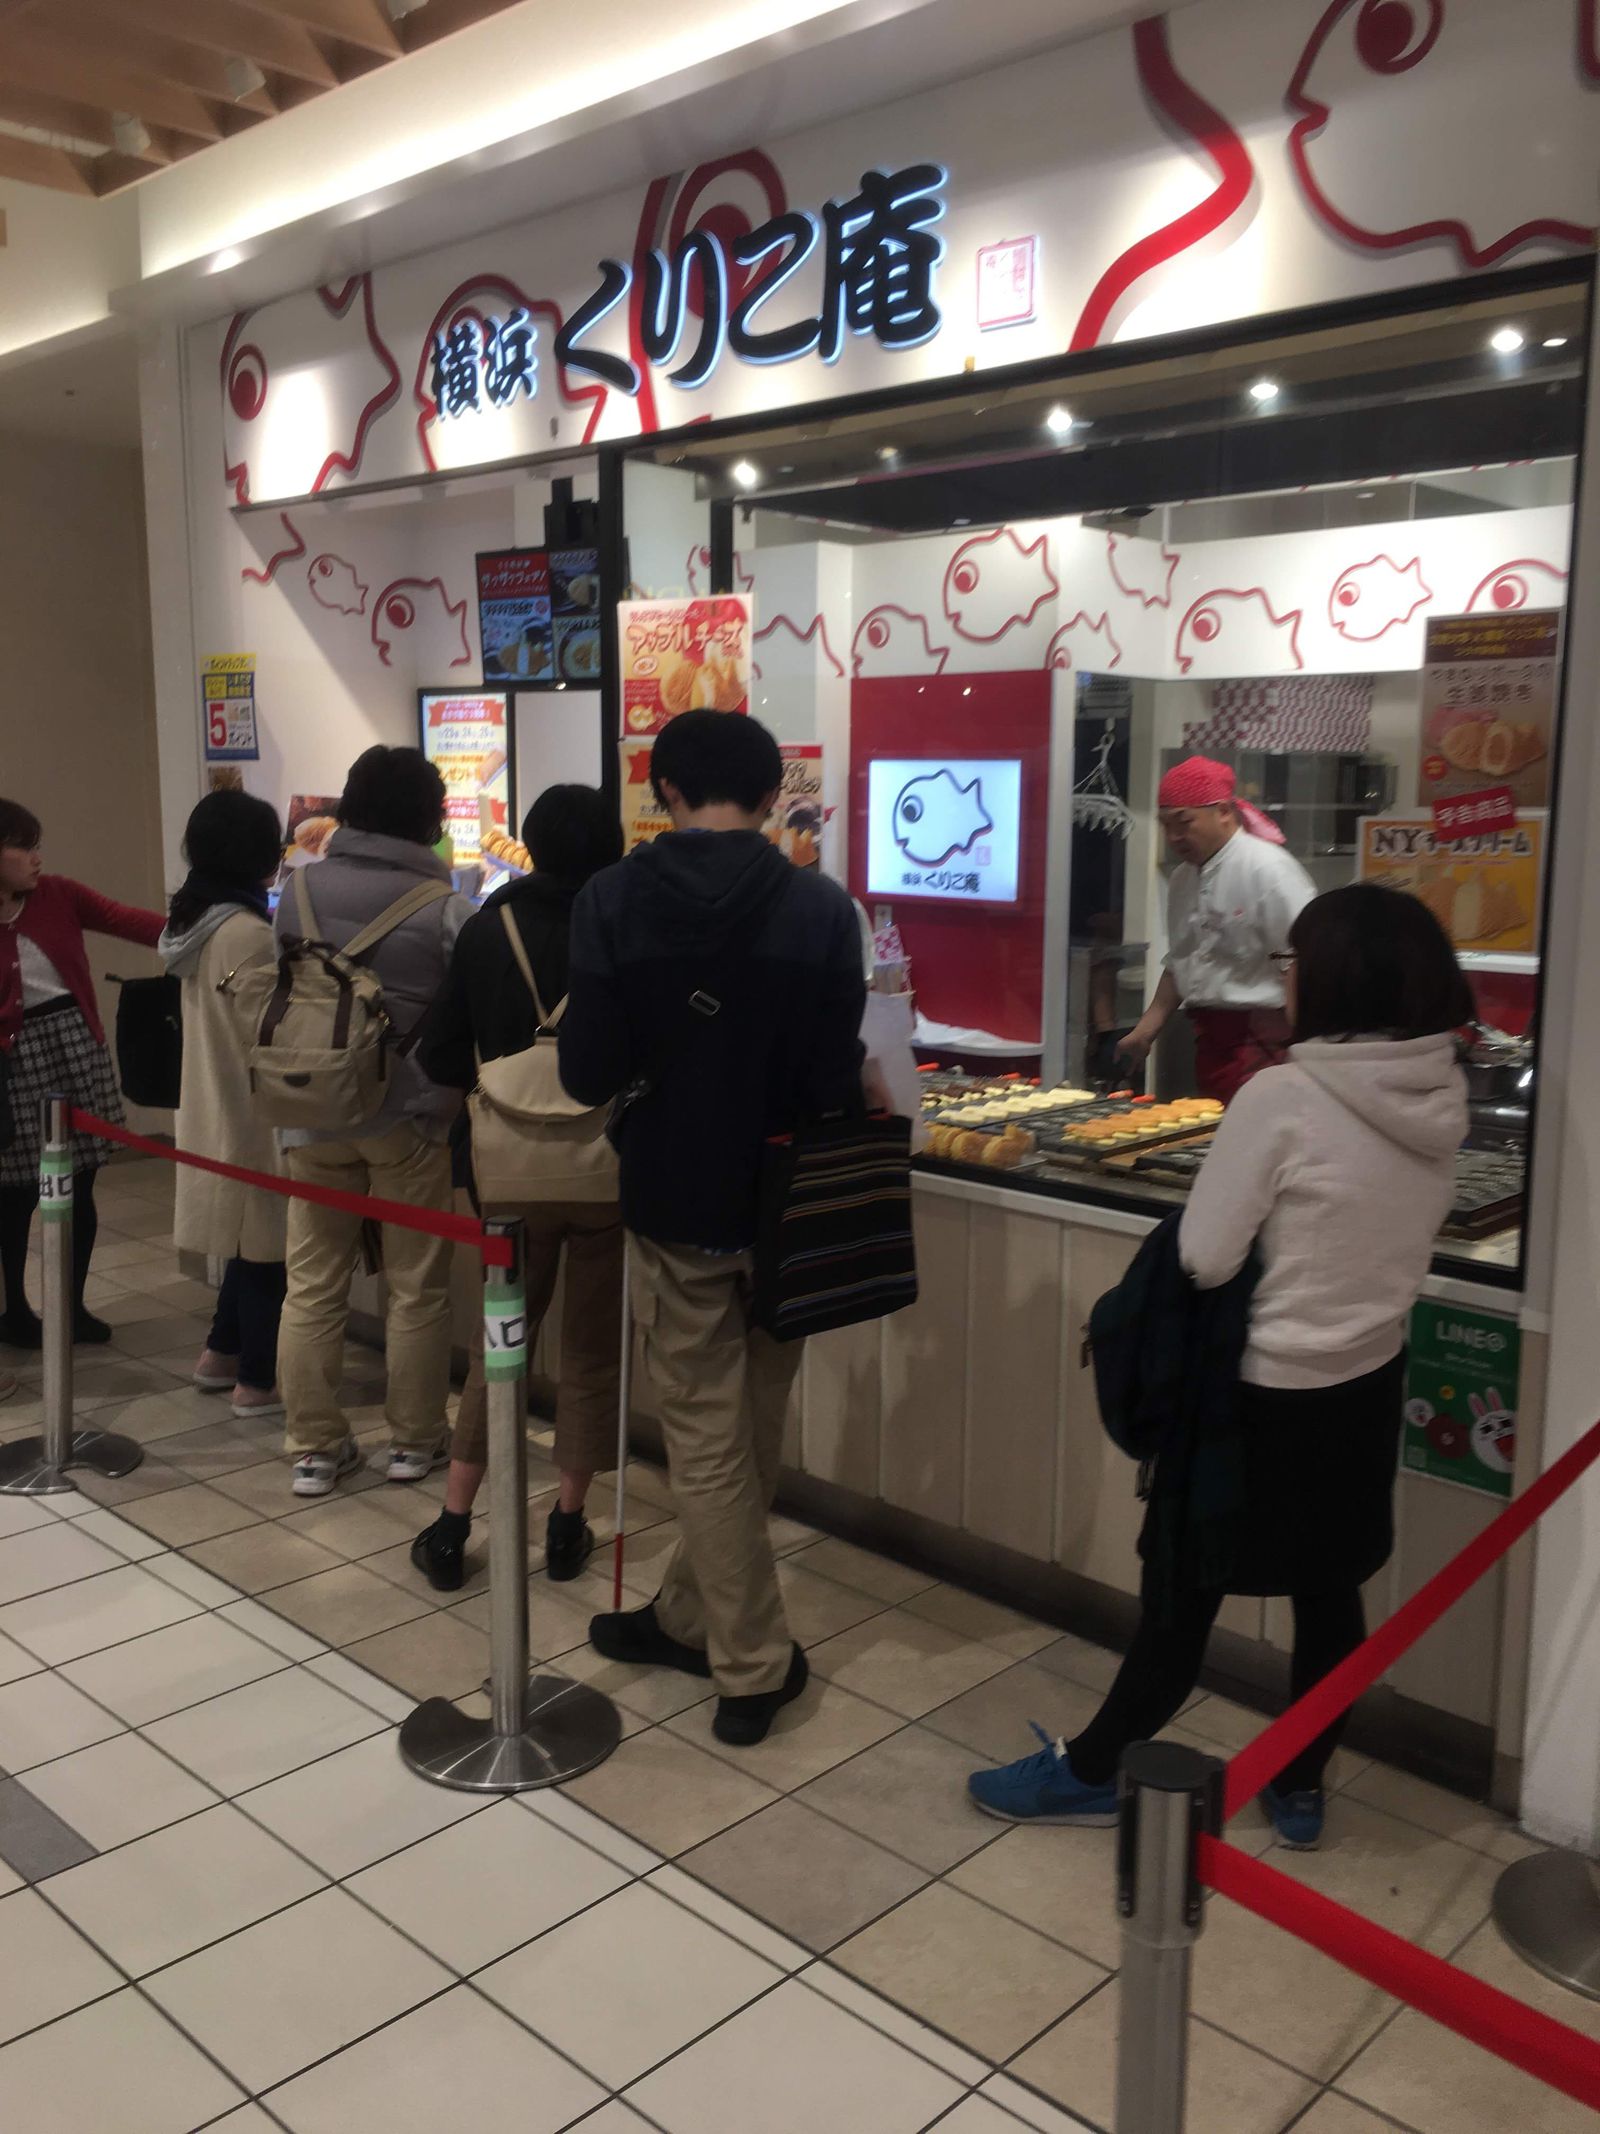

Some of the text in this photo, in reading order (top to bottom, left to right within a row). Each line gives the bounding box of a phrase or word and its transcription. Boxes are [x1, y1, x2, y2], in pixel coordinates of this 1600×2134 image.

[431, 161, 949, 422] 横浜 くりこ庵
[209, 702, 228, 748] 5
[924, 871, 981, 893] くりこ庵
[1437, 1320, 1506, 1351] LINE@
